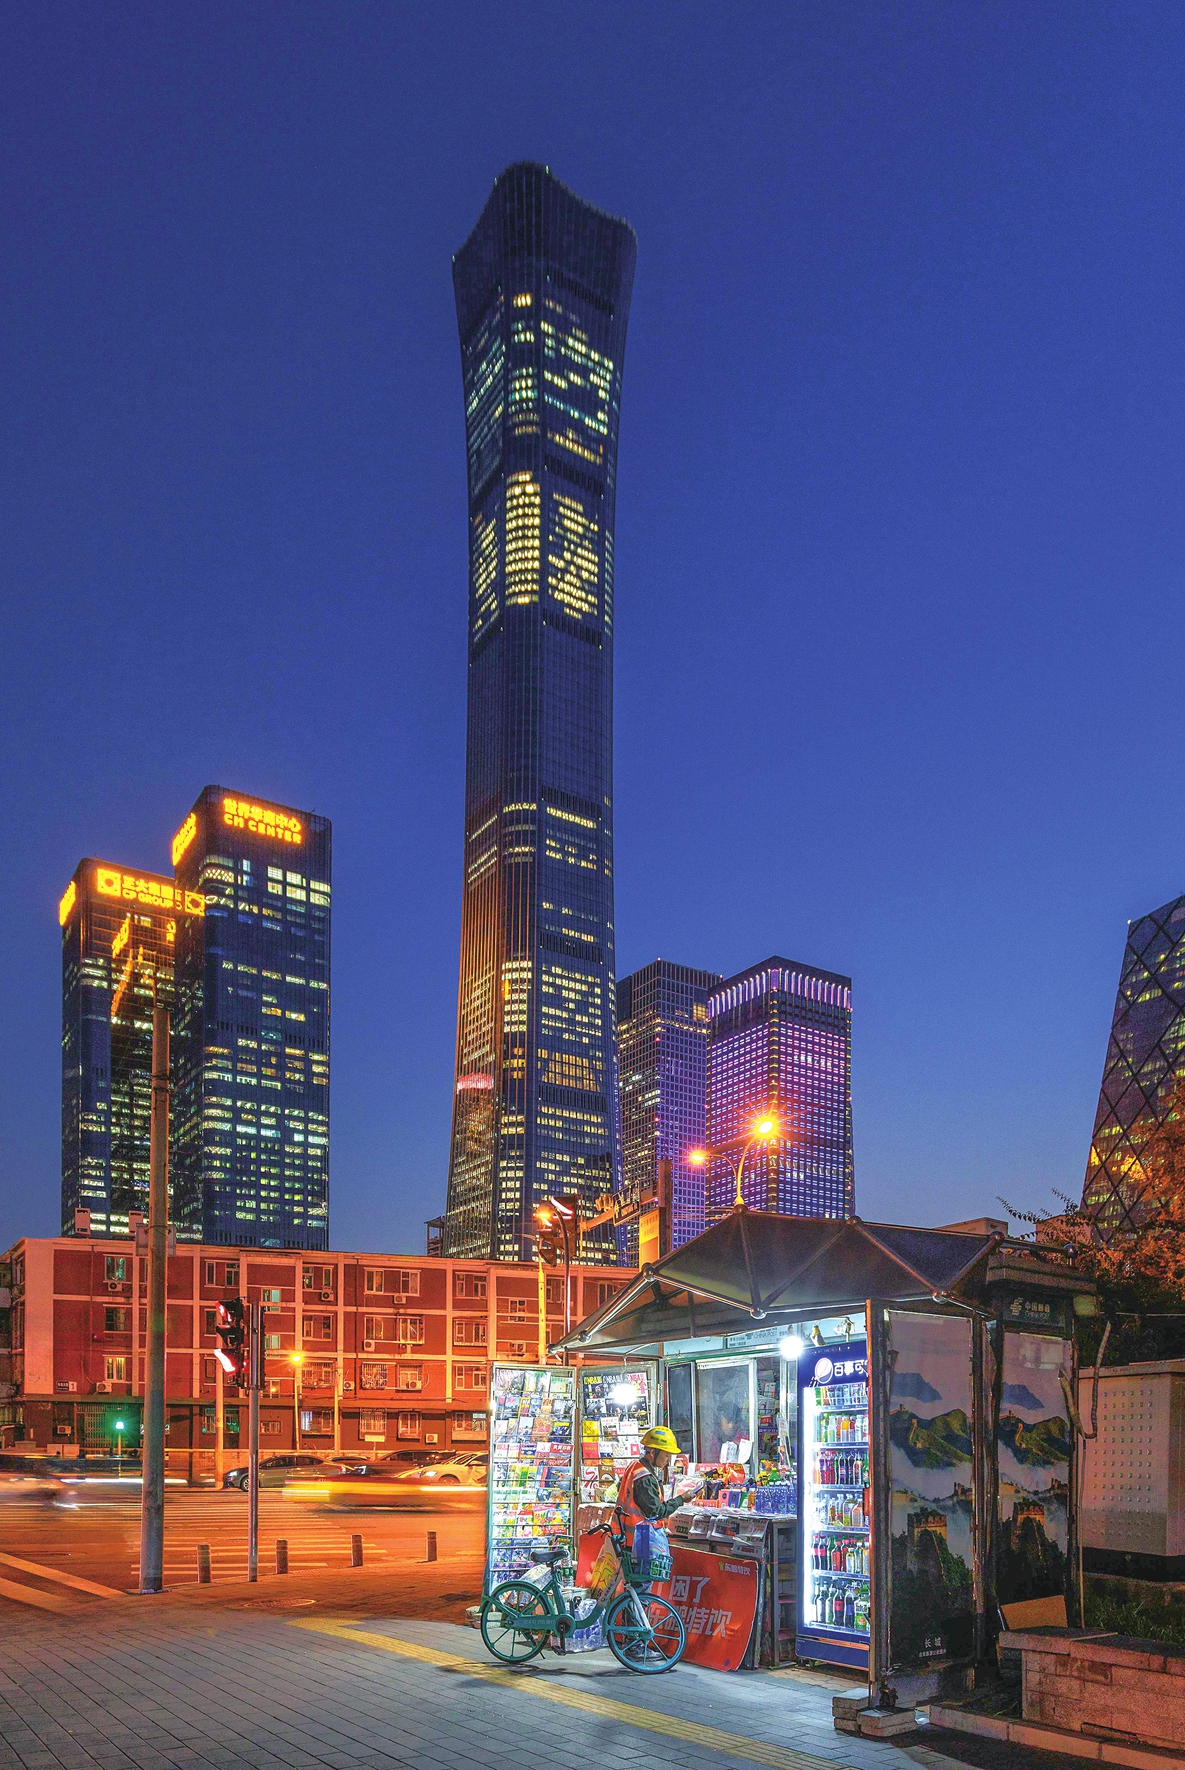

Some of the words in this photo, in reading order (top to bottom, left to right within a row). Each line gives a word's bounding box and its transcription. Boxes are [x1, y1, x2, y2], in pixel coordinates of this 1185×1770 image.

[224, 813, 244, 828] CM
[248, 820, 302, 844] CENTER
[122, 889, 137, 900] CP
[138, 892, 174, 908] GROUP
[1025, 1301, 1050, 1313] 中国邮政
[834, 1359, 869, 1378] 百事可
